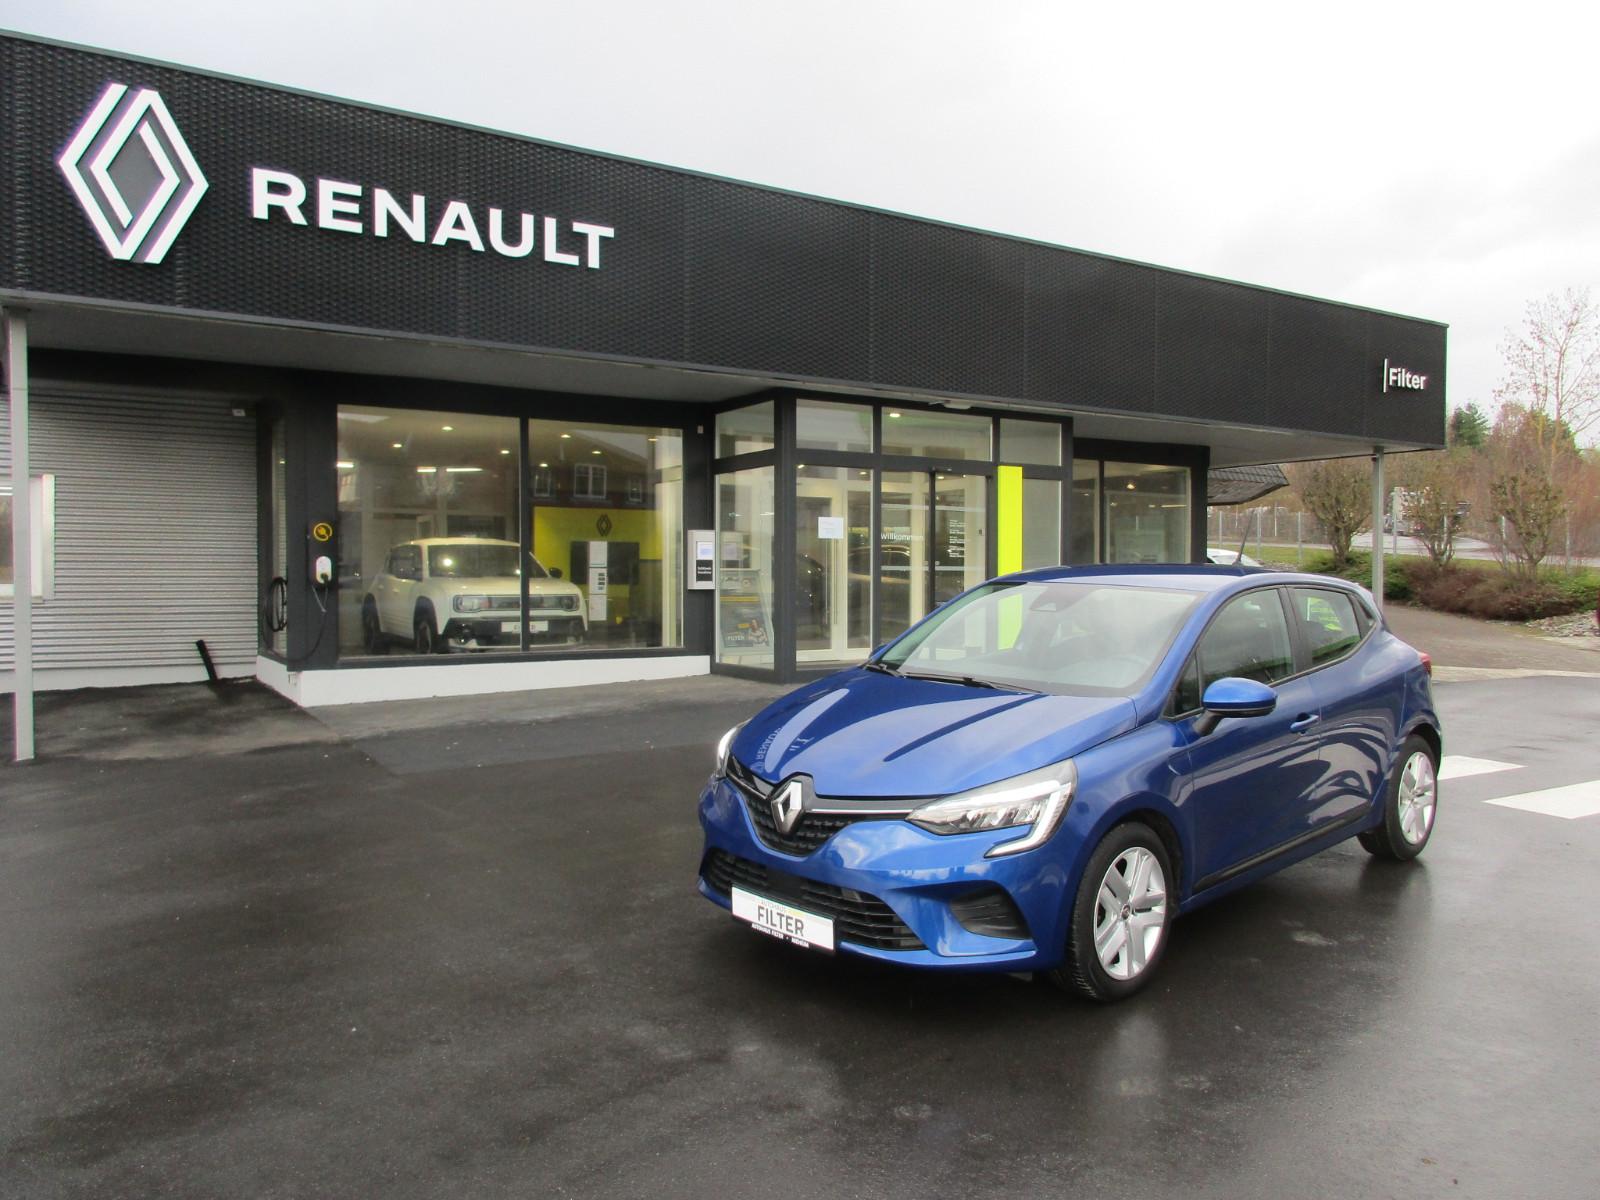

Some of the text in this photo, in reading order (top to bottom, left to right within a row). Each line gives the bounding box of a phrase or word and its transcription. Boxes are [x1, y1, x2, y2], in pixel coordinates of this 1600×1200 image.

[252, 167, 615, 269] RENAULT
[1389, 367, 1427, 390] Filter
[758, 905, 804, 936] FILTER
